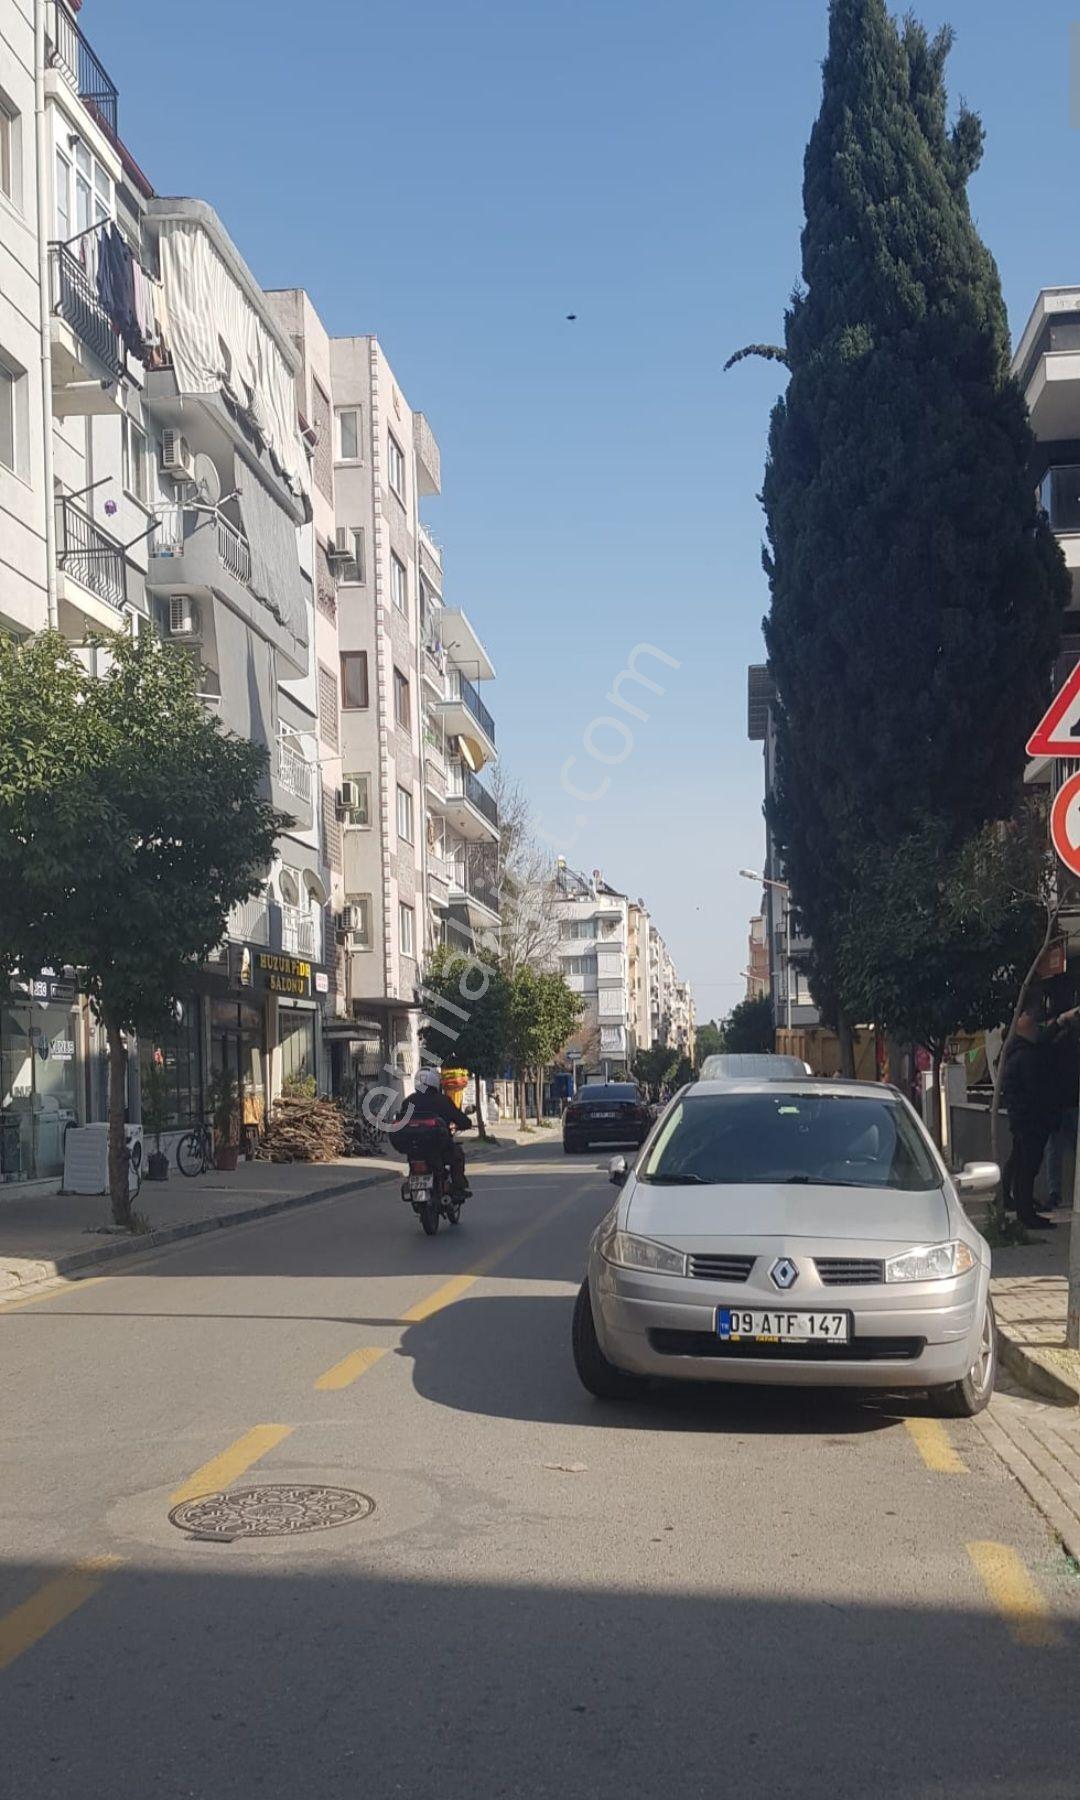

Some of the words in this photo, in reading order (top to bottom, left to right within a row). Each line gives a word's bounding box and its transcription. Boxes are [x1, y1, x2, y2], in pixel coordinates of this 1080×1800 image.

[260, 953, 290, 974] HUZUR
[270, 974, 304, 994] SALONU
[730, 1312, 753, 1333] 09
[761, 1313, 798, 1334] ATF
[808, 1315, 843, 1336] 147
